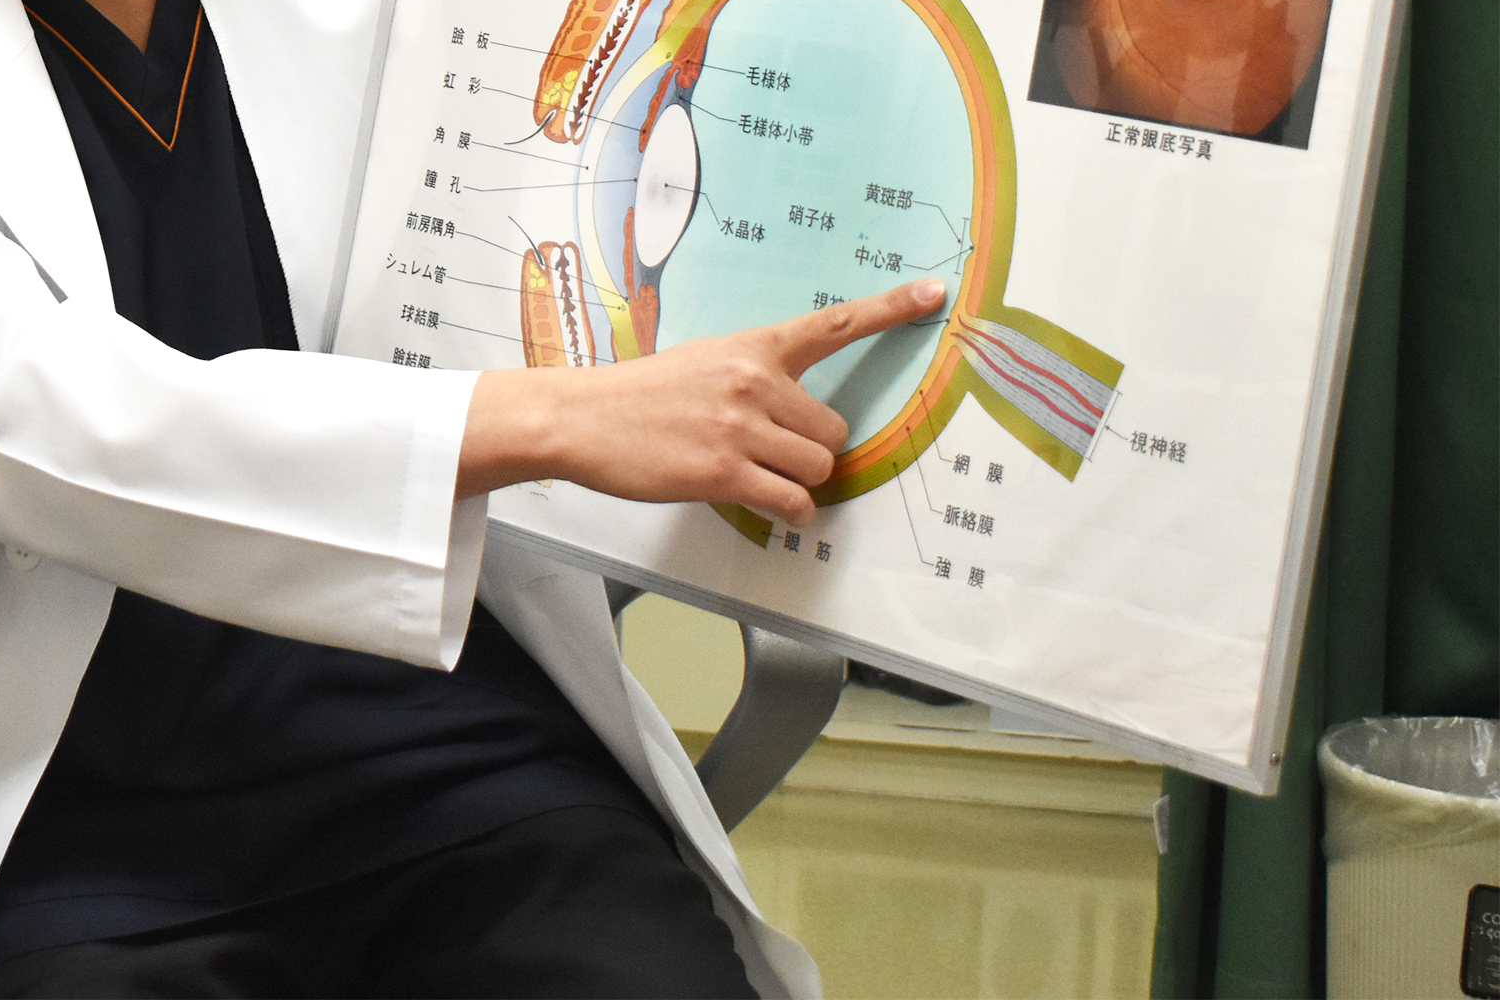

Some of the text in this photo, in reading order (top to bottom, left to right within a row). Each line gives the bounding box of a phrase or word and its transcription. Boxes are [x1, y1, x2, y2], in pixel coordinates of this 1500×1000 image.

[442, 71, 481, 95] 虹彩
[746, 66, 791, 92] 毛様体
[433, 125, 472, 150] 角膜
[737, 114, 814, 146] 毛様体小帯
[1105, 121, 1214, 161] 正常眼底写真
[424, 169, 462, 194] 瞳孔
[864, 182, 914, 211] 黄斑部
[405, 211, 456, 239] 前房隅角
[720, 216, 766, 243] 水晶体
[788, 204, 836, 232] 硝子体
[386, 253, 447, 285] シュレム管
[855, 245, 903, 274] 中心窩
[400, 304, 441, 330] 球結膜
[1131, 430, 1187, 464] 視神経
[953, 453, 1004, 485] 網膜
[943, 504, 995, 537] 脈絡膜
[784, 530, 832, 562] 眼筋
[935, 556, 986, 589] 強膜
